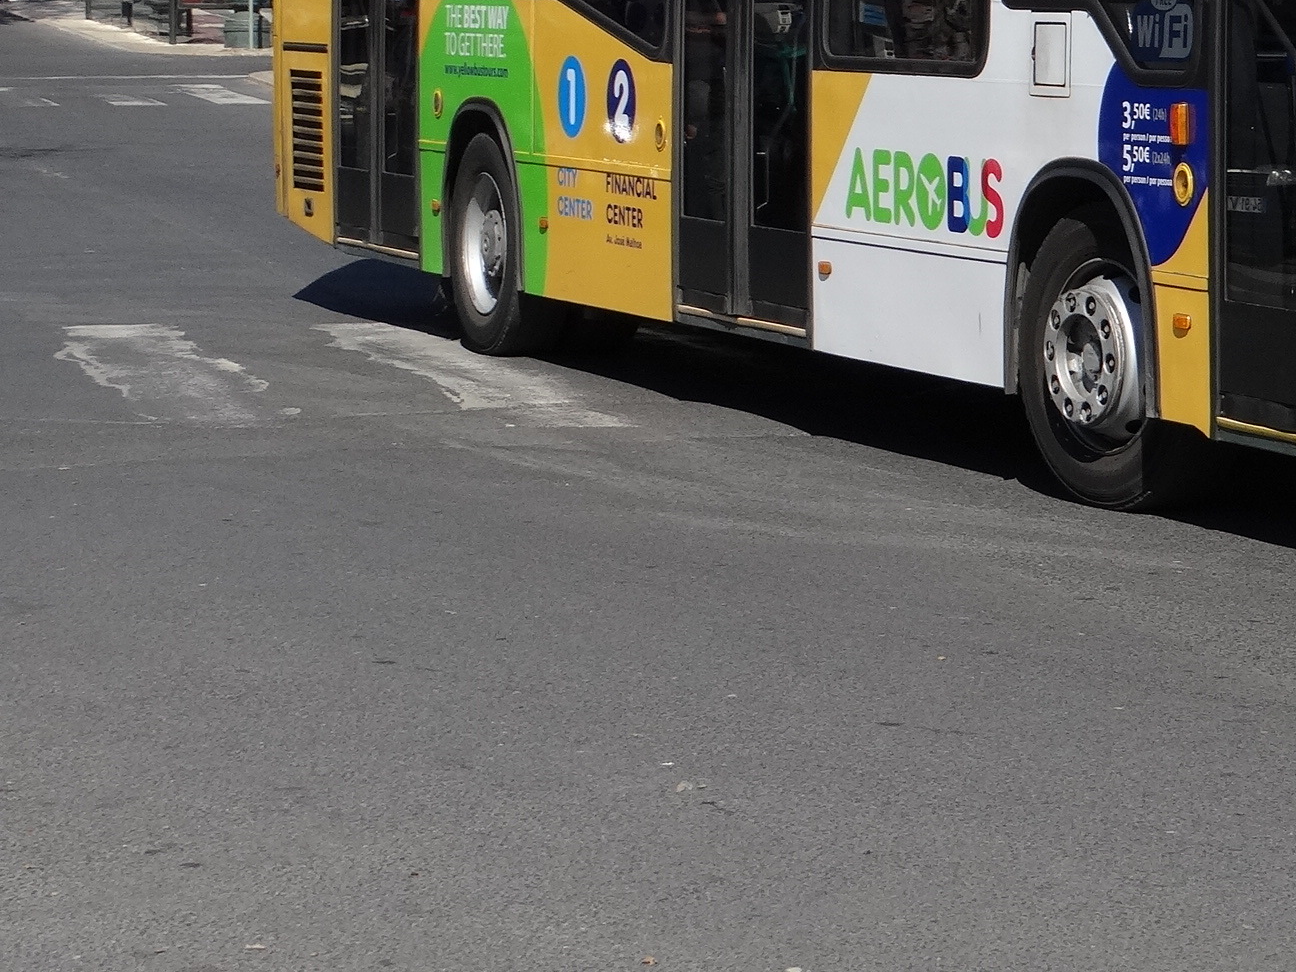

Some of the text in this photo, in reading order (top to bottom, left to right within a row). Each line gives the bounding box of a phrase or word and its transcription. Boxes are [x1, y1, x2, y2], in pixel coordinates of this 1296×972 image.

[445, 4, 509, 30] THE BEST WAY
[444, 32, 457, 56] TO
[458, 33, 475, 57] GET
[566, 68, 577, 125] 1
[614, 70, 630, 130] 2
[558, 167, 577, 188] CITY
[606, 173, 657, 201] FINANCIAL
[846, 147, 1004, 238] AEROBUS
[558, 196, 592, 220] CENTER
[606, 203, 643, 229] CENTER
